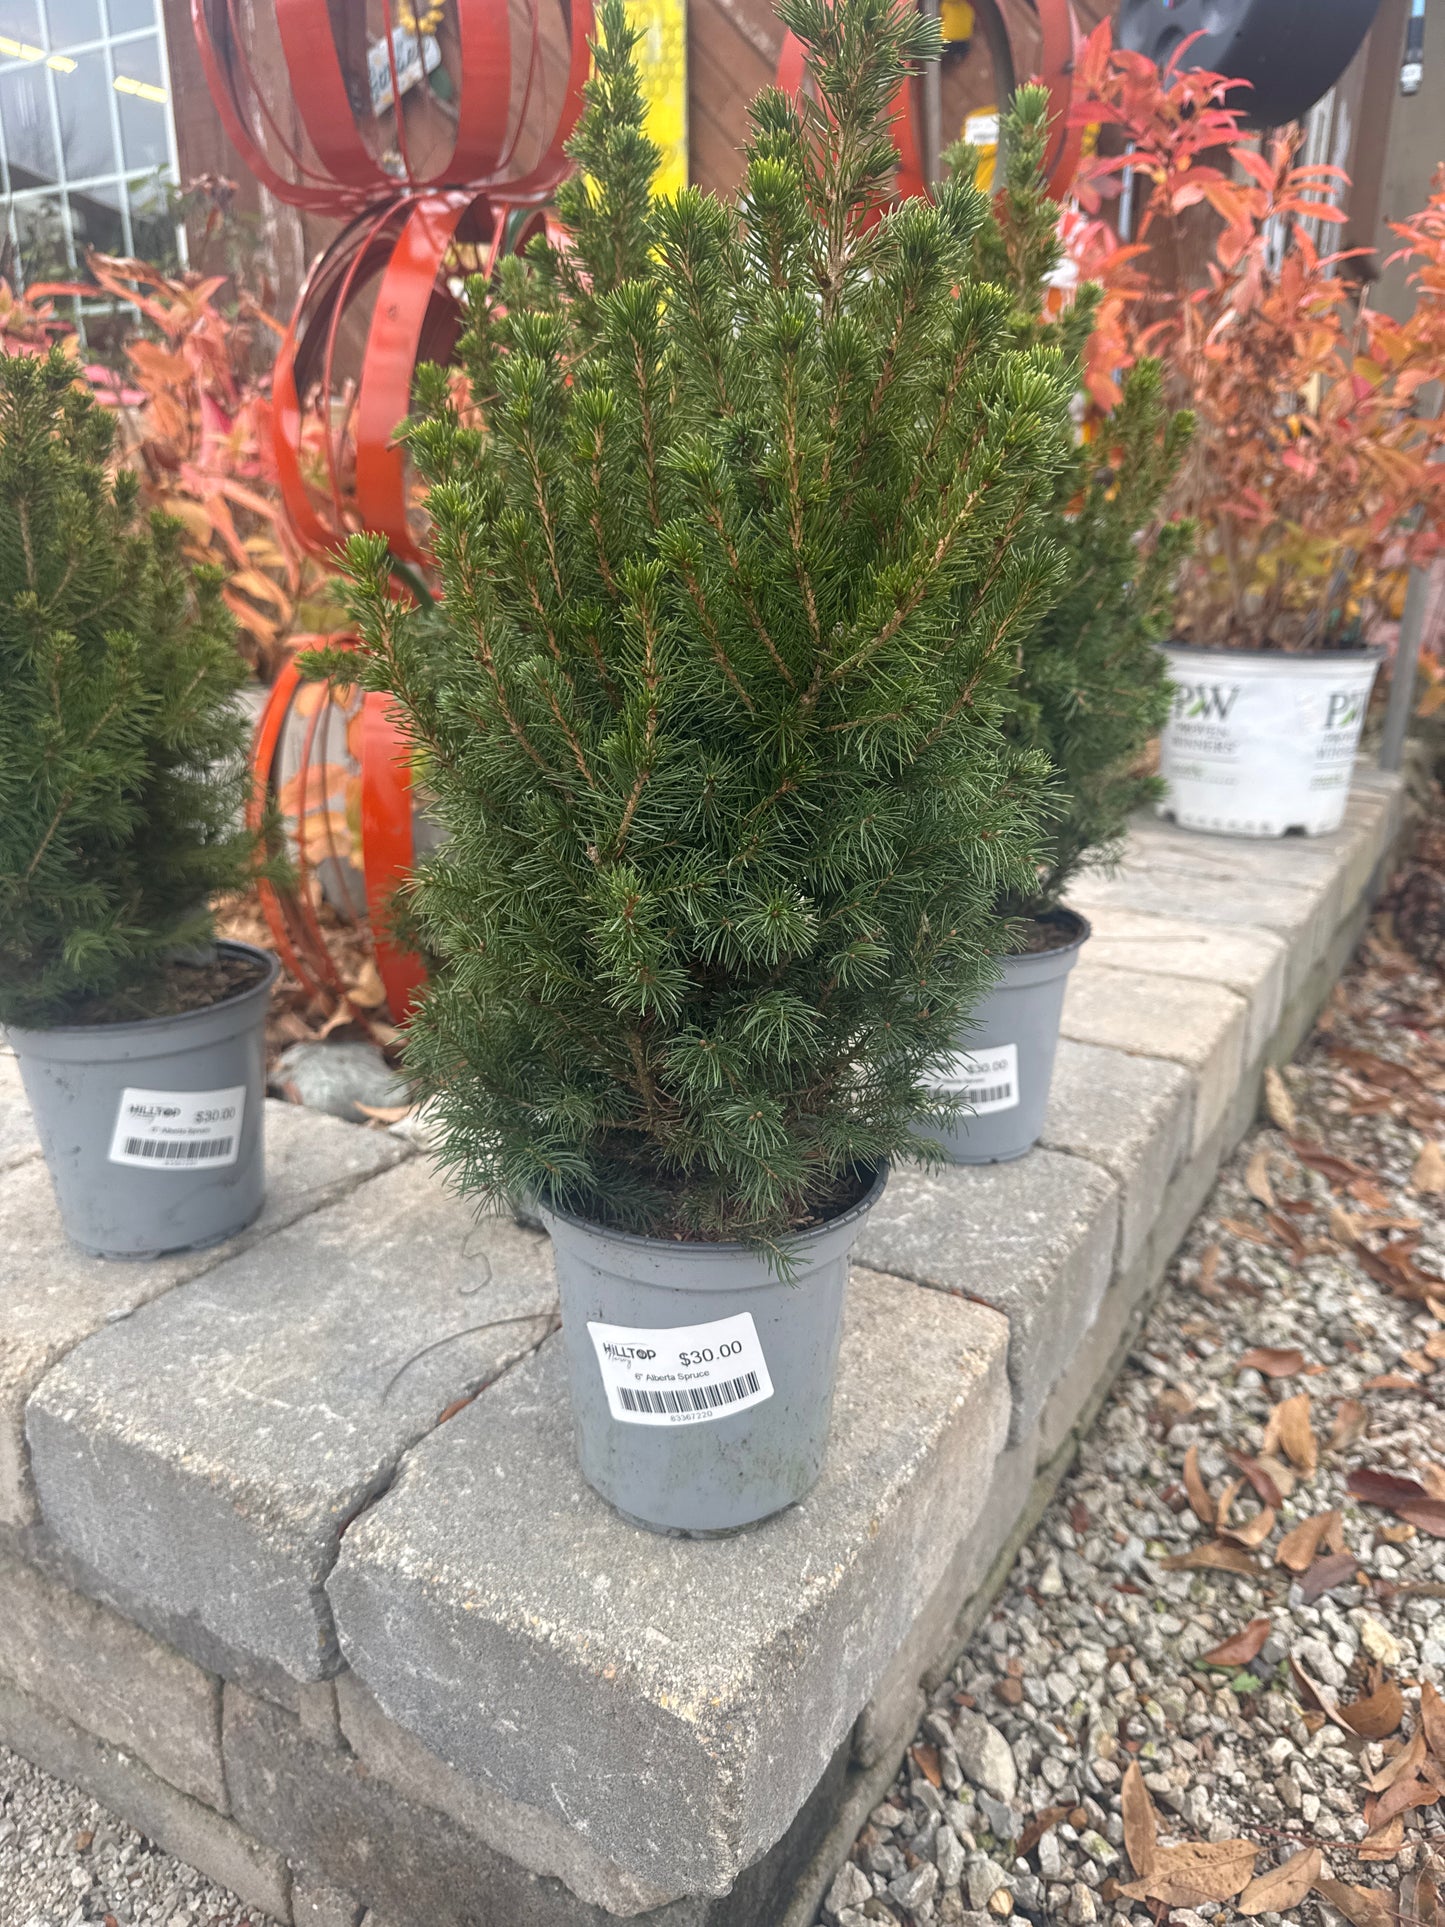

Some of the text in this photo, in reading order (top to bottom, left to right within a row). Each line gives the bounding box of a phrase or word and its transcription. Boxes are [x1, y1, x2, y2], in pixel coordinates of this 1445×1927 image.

[195, 1107, 236, 1123] $30.00
[603, 1342, 656, 1360] HILLTOP
[679, 1340, 742, 1367] $30.00
[646, 1372, 676, 1382] Alberta
[677, 1370, 710, 1382] Spruce
